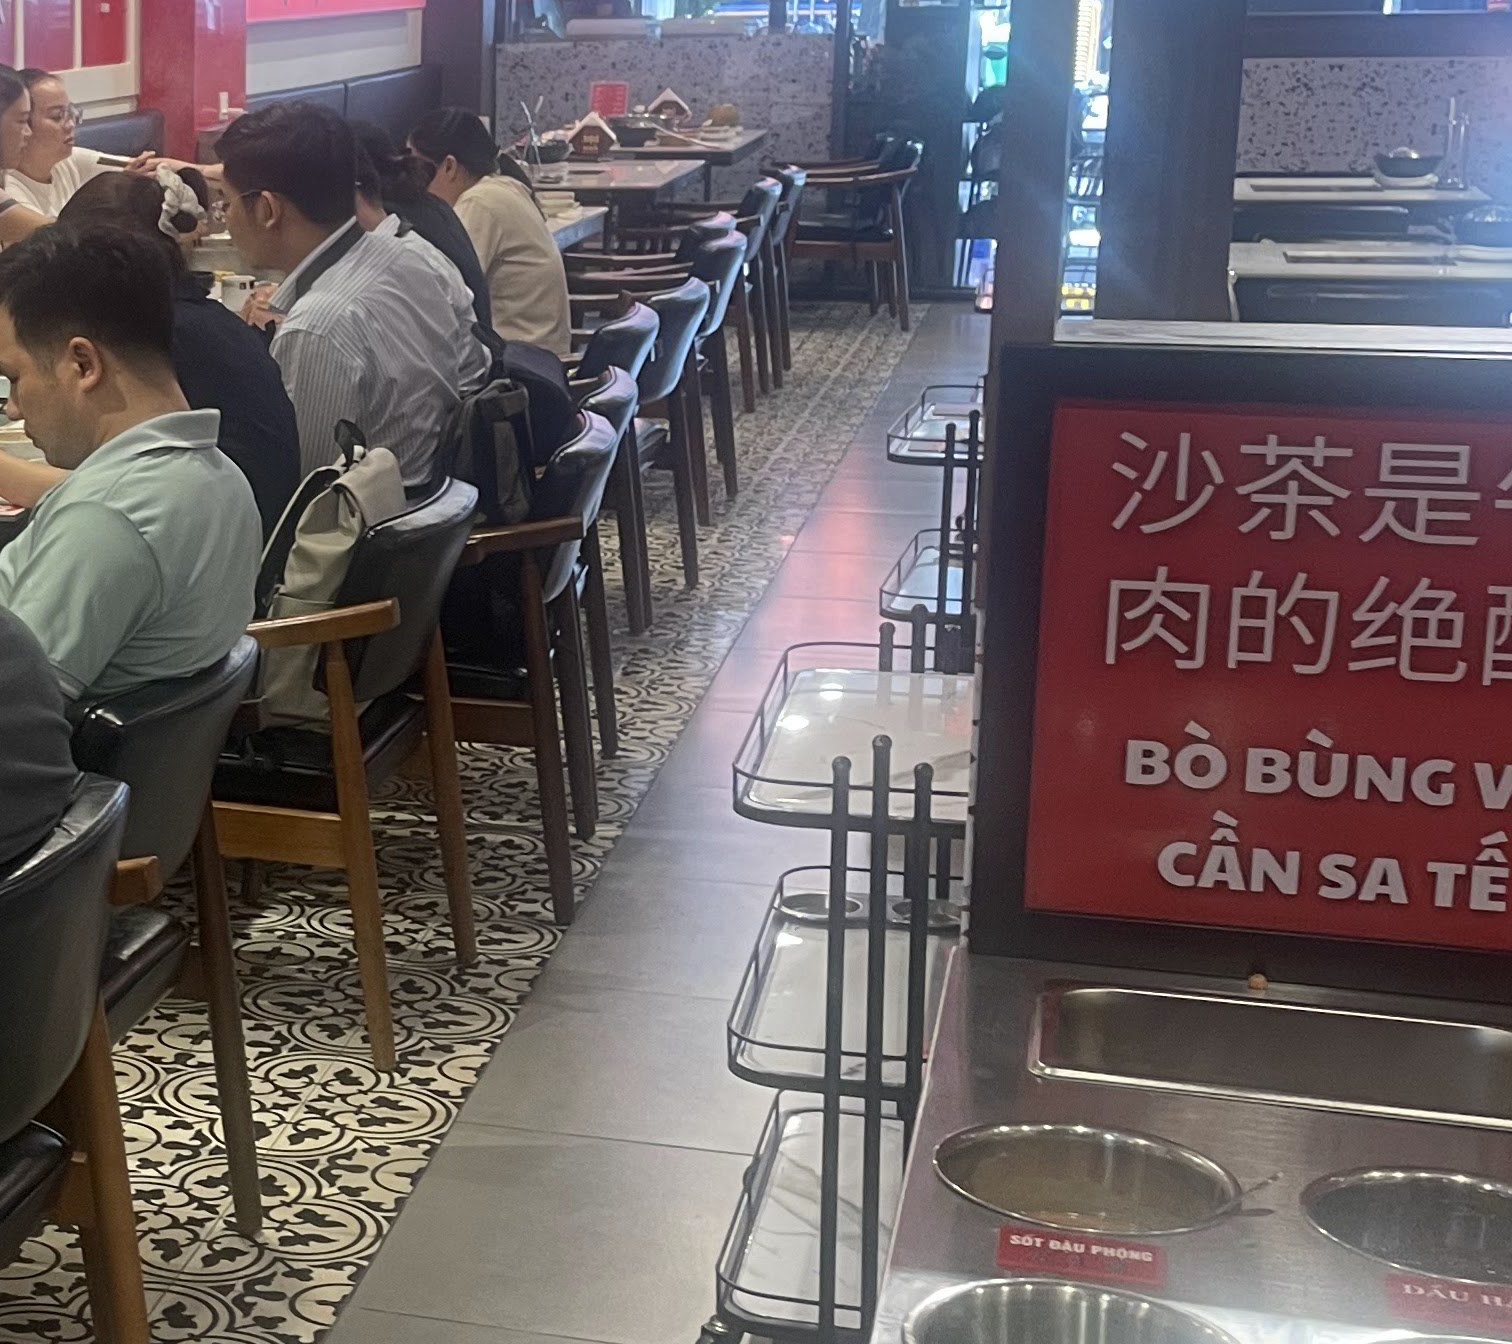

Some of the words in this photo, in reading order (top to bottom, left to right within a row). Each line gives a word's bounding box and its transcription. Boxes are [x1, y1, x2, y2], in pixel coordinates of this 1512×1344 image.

[1112, 432, 1512, 546] 沙茶是
[1106, 565, 1512, 686] 肉的绝
[1125, 721, 1228, 789] BÒ
[1245, 729, 1456, 806] BÙNG
[1157, 810, 1301, 895] CẦN
[1318, 854, 1409, 905] SA
[1427, 831, 1510, 912] TẾ
